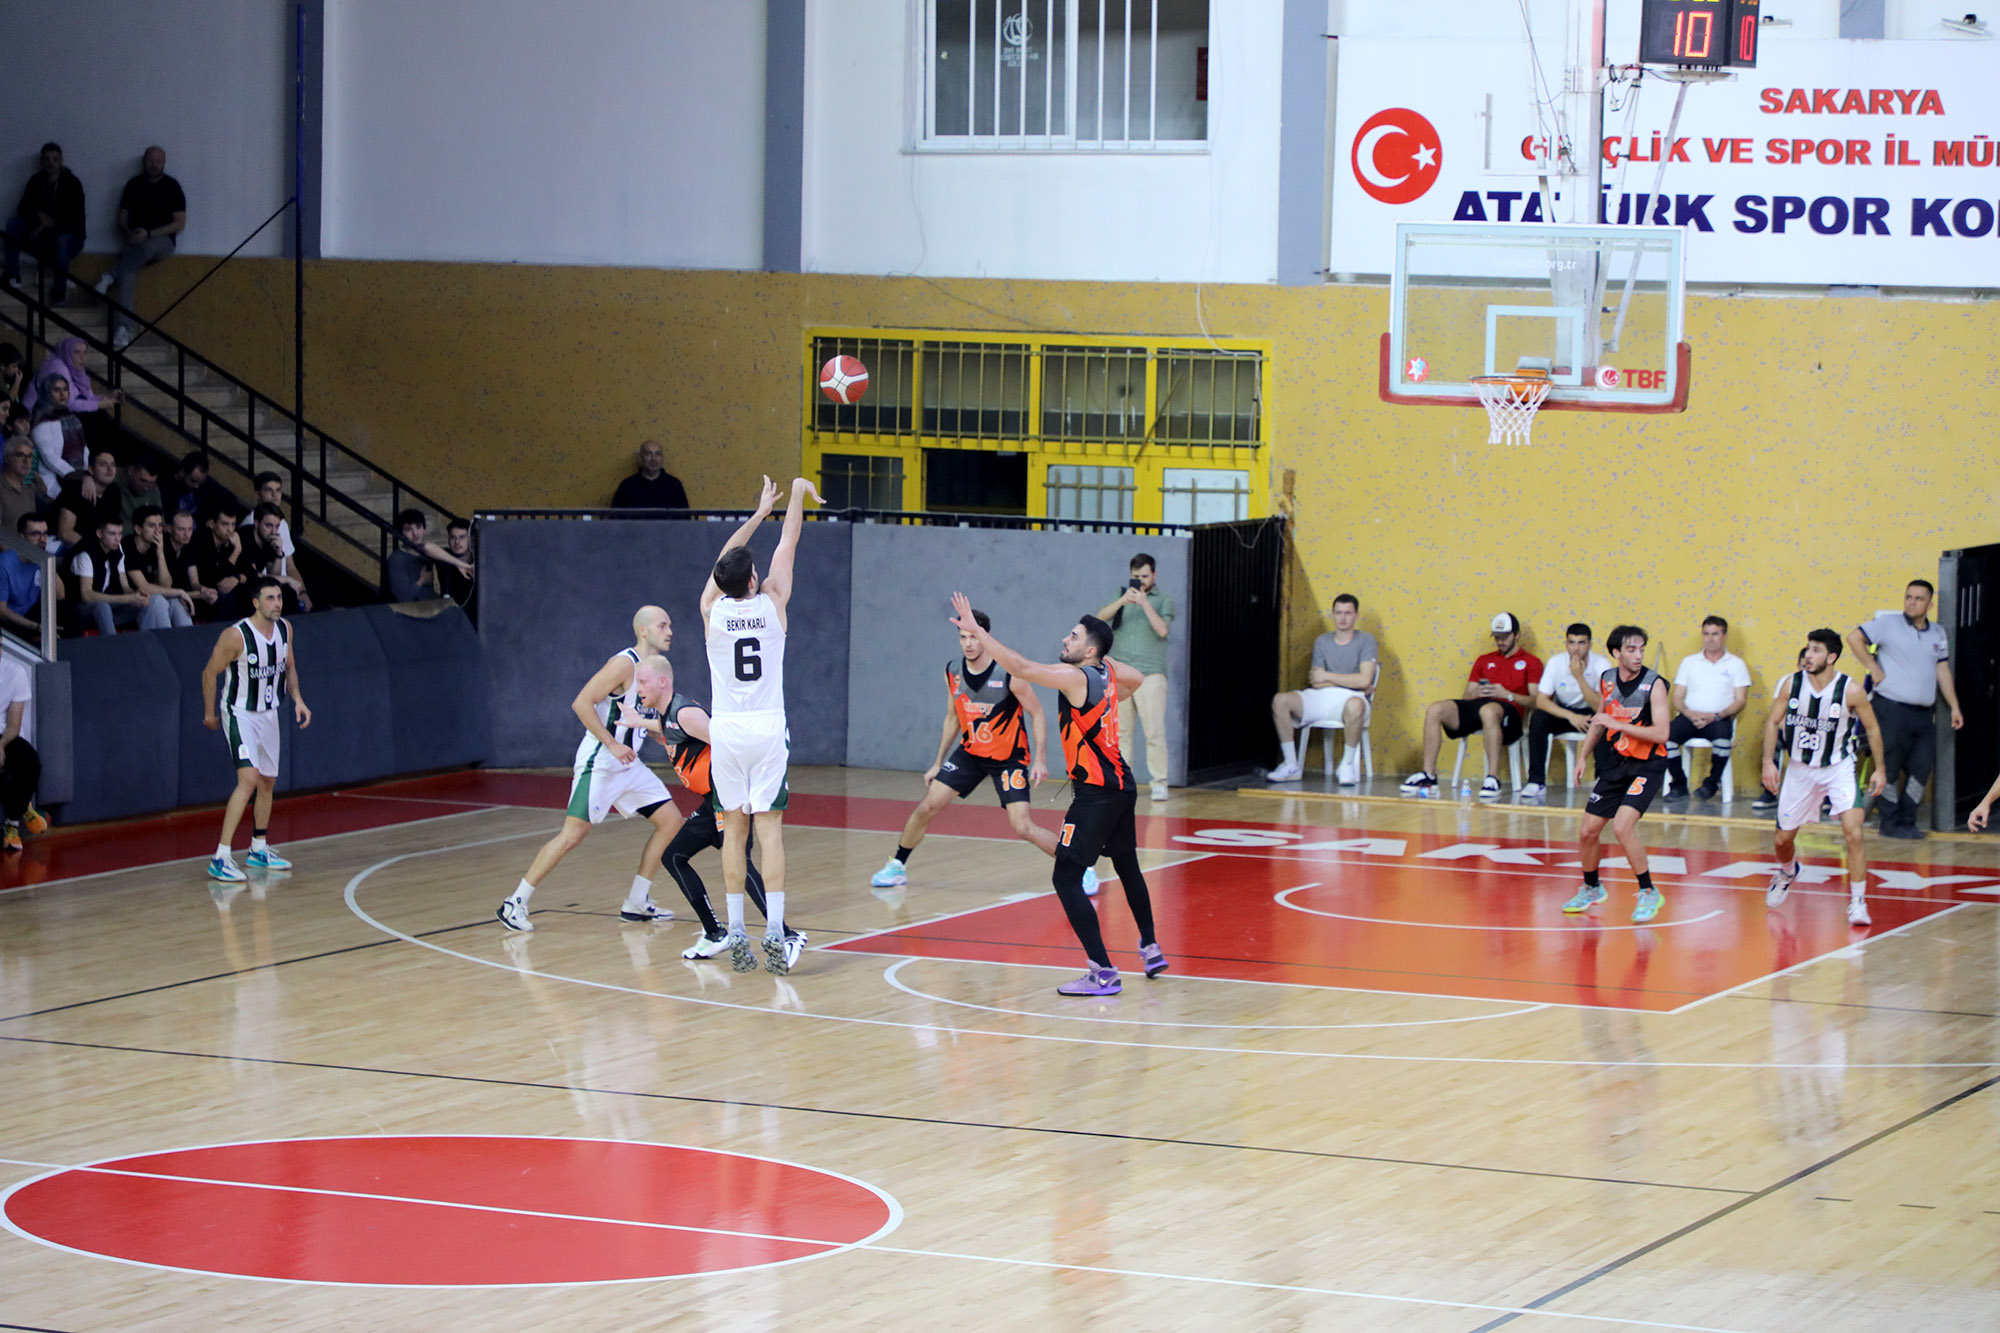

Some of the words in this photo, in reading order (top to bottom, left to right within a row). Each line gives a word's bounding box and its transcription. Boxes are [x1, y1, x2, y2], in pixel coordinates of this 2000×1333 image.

[1673, 10, 1714, 57] 10
[1759, 88, 1945, 115] SAKARYA
[1521, 130, 1692, 168] GÇLİK
[1702, 138, 1754, 163] VE
[1765, 138, 1872, 165] SPOR
[1884, 133, 1921, 166] İL
[1933, 135, 2000, 167] MÜ
[1453, 184, 1715, 232] ATAÜRK
[1733, 195, 1891, 235] SPOR
[1911, 198, 2000, 237] KO
[1622, 369, 1667, 389] TBF
[734, 637, 762, 681] 6
[967, 721, 993, 744] 16
[1798, 731, 1820, 751] 28
[1001, 769, 1026, 792] 16
[1626, 776, 1648, 796] 5
